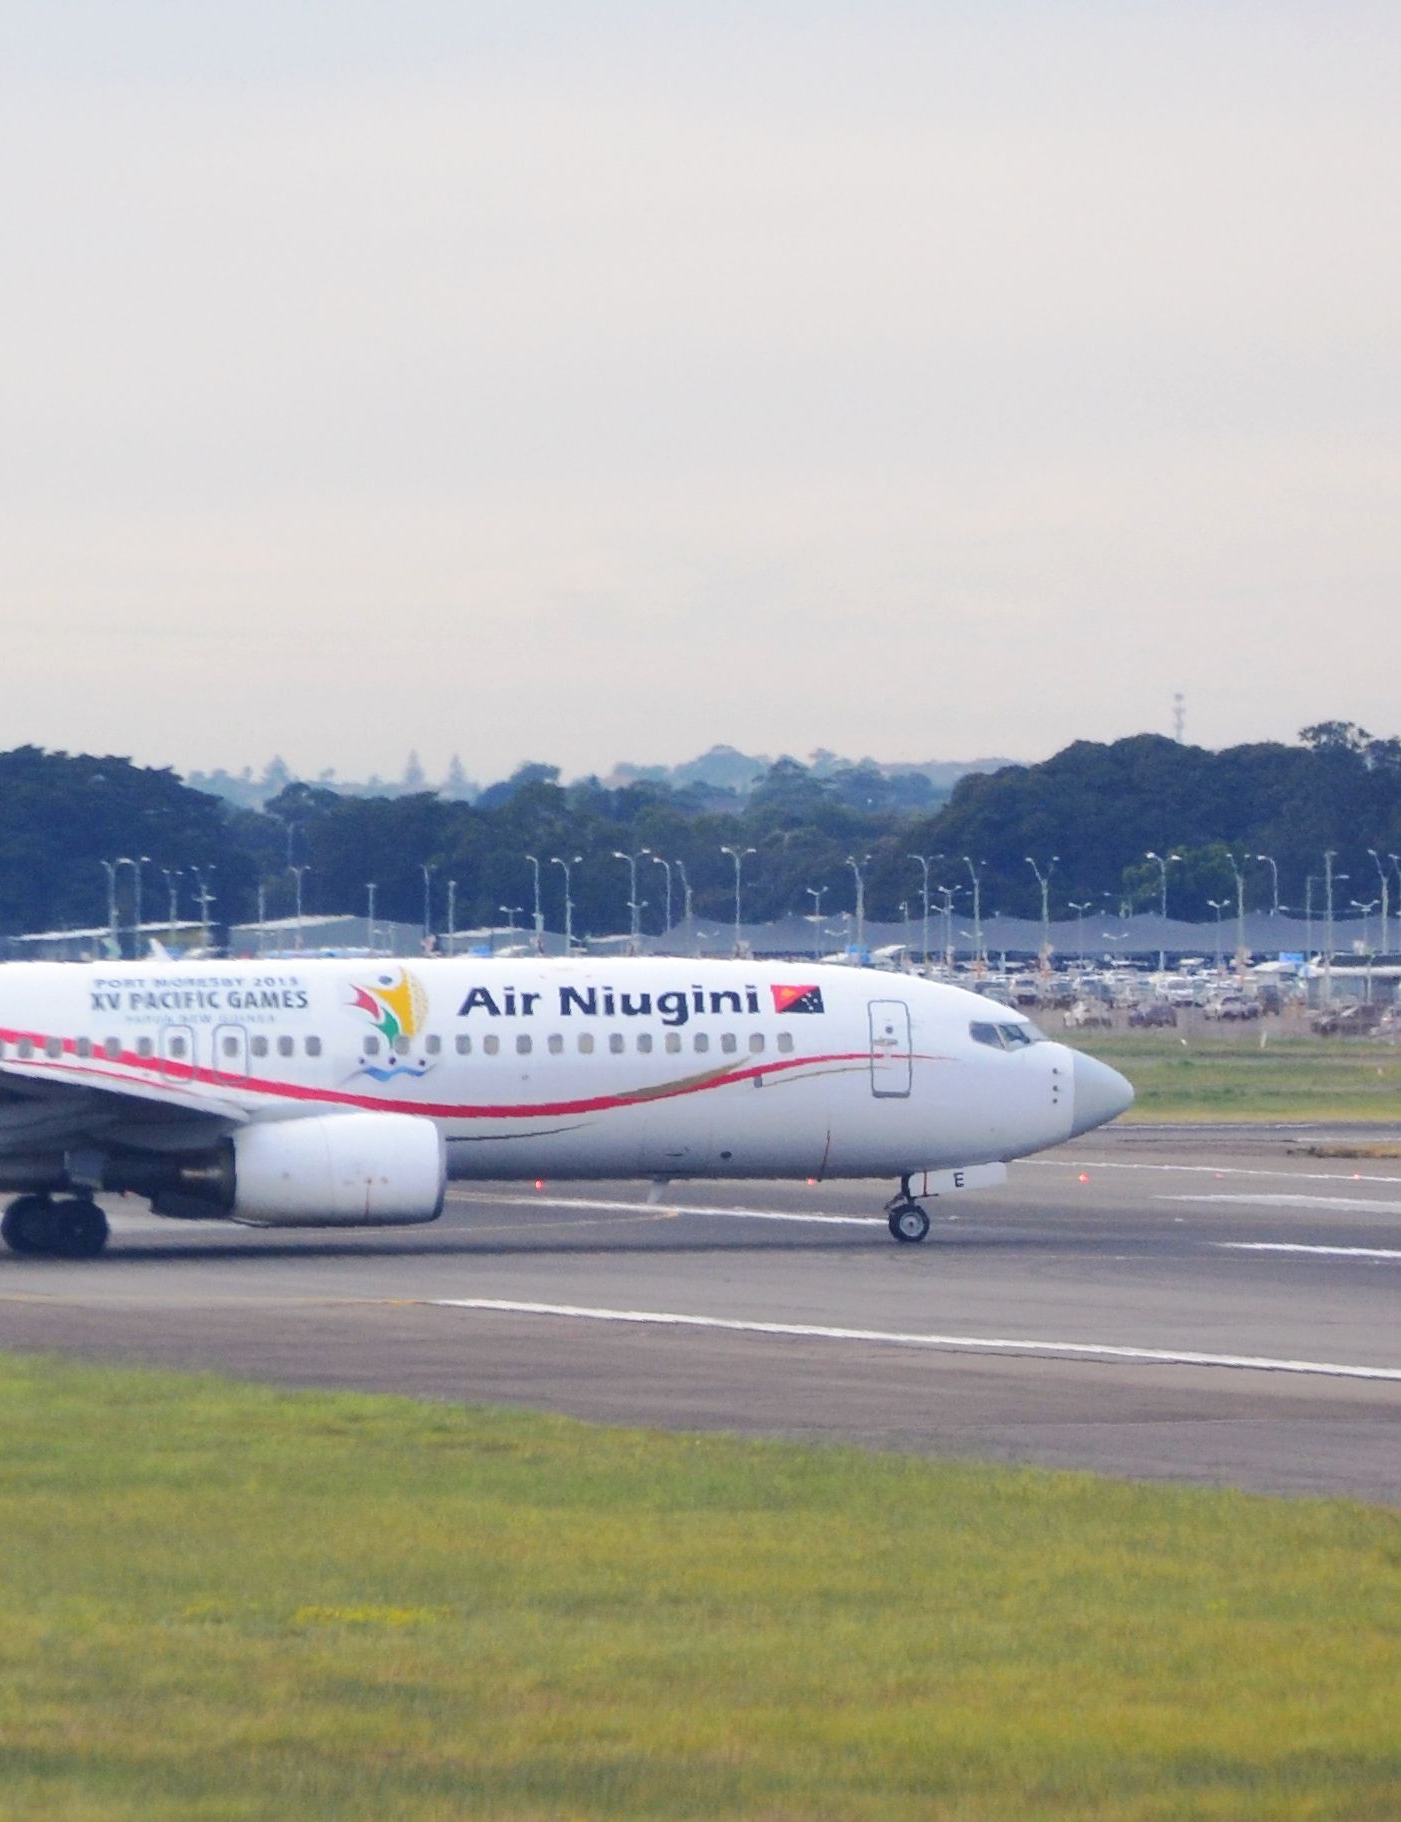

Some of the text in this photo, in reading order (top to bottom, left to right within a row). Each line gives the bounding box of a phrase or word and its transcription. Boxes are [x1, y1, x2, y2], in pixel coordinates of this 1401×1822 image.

[94, 977, 145, 989] PORT
[153, 977, 245, 988] MORESBY
[89, 989, 309, 1011] XV PACIFIC GAMES
[456, 983, 760, 1027] Air Niugini
[953, 1172, 965, 1188] E
